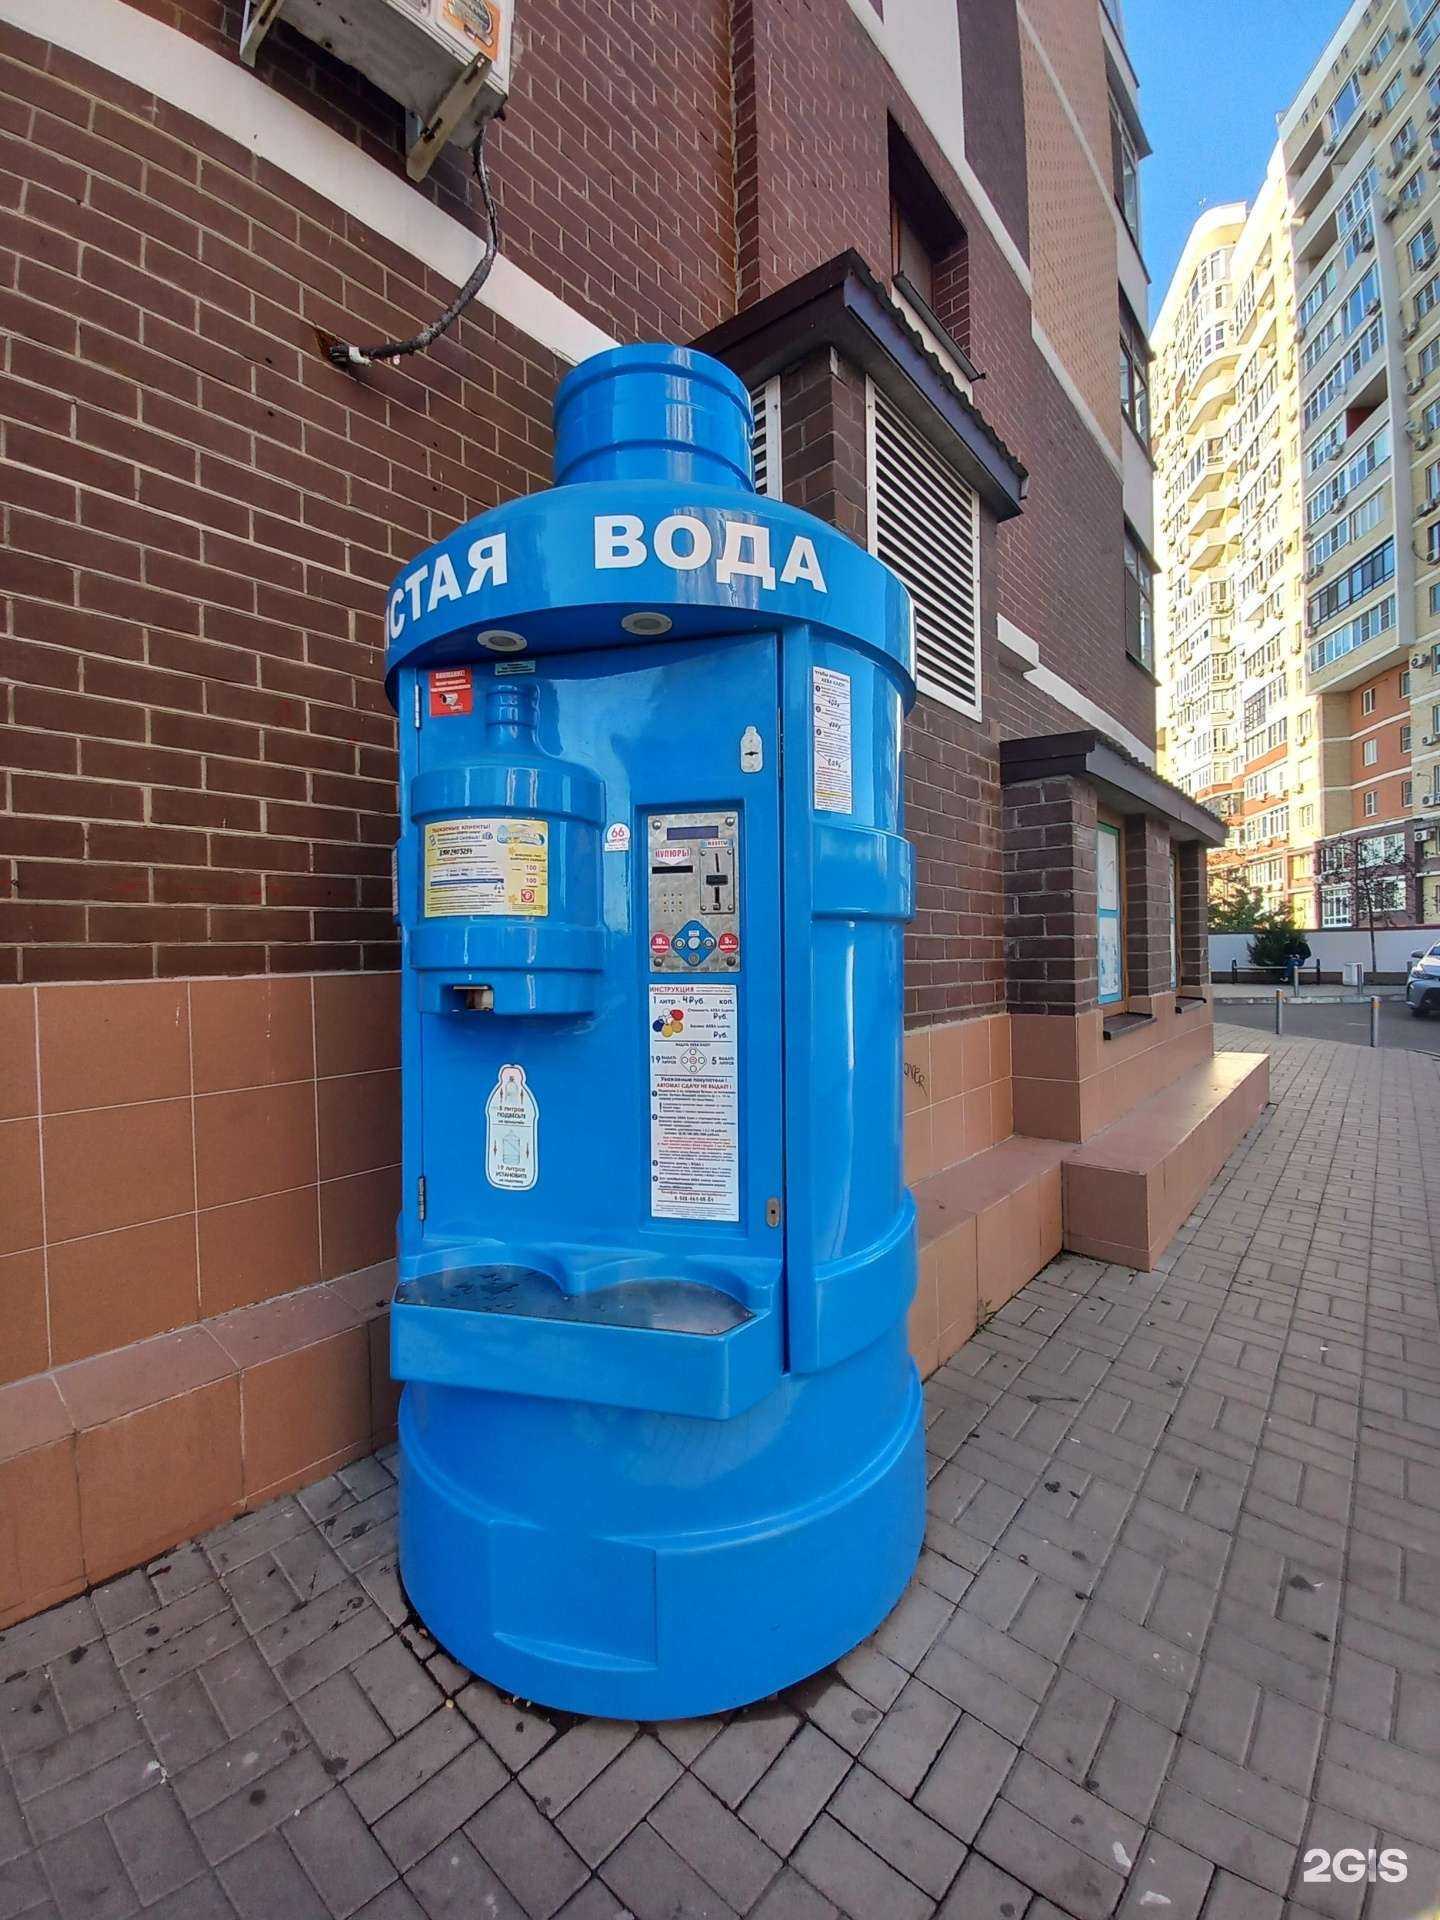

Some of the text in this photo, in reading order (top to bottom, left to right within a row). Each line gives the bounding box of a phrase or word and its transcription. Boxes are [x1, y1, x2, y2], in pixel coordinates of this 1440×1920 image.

[594, 514, 828, 593] ВОДА
[611, 827, 625, 838] 66
[651, 1055, 661, 1064] 19
[712, 1056, 717, 1065] 5
